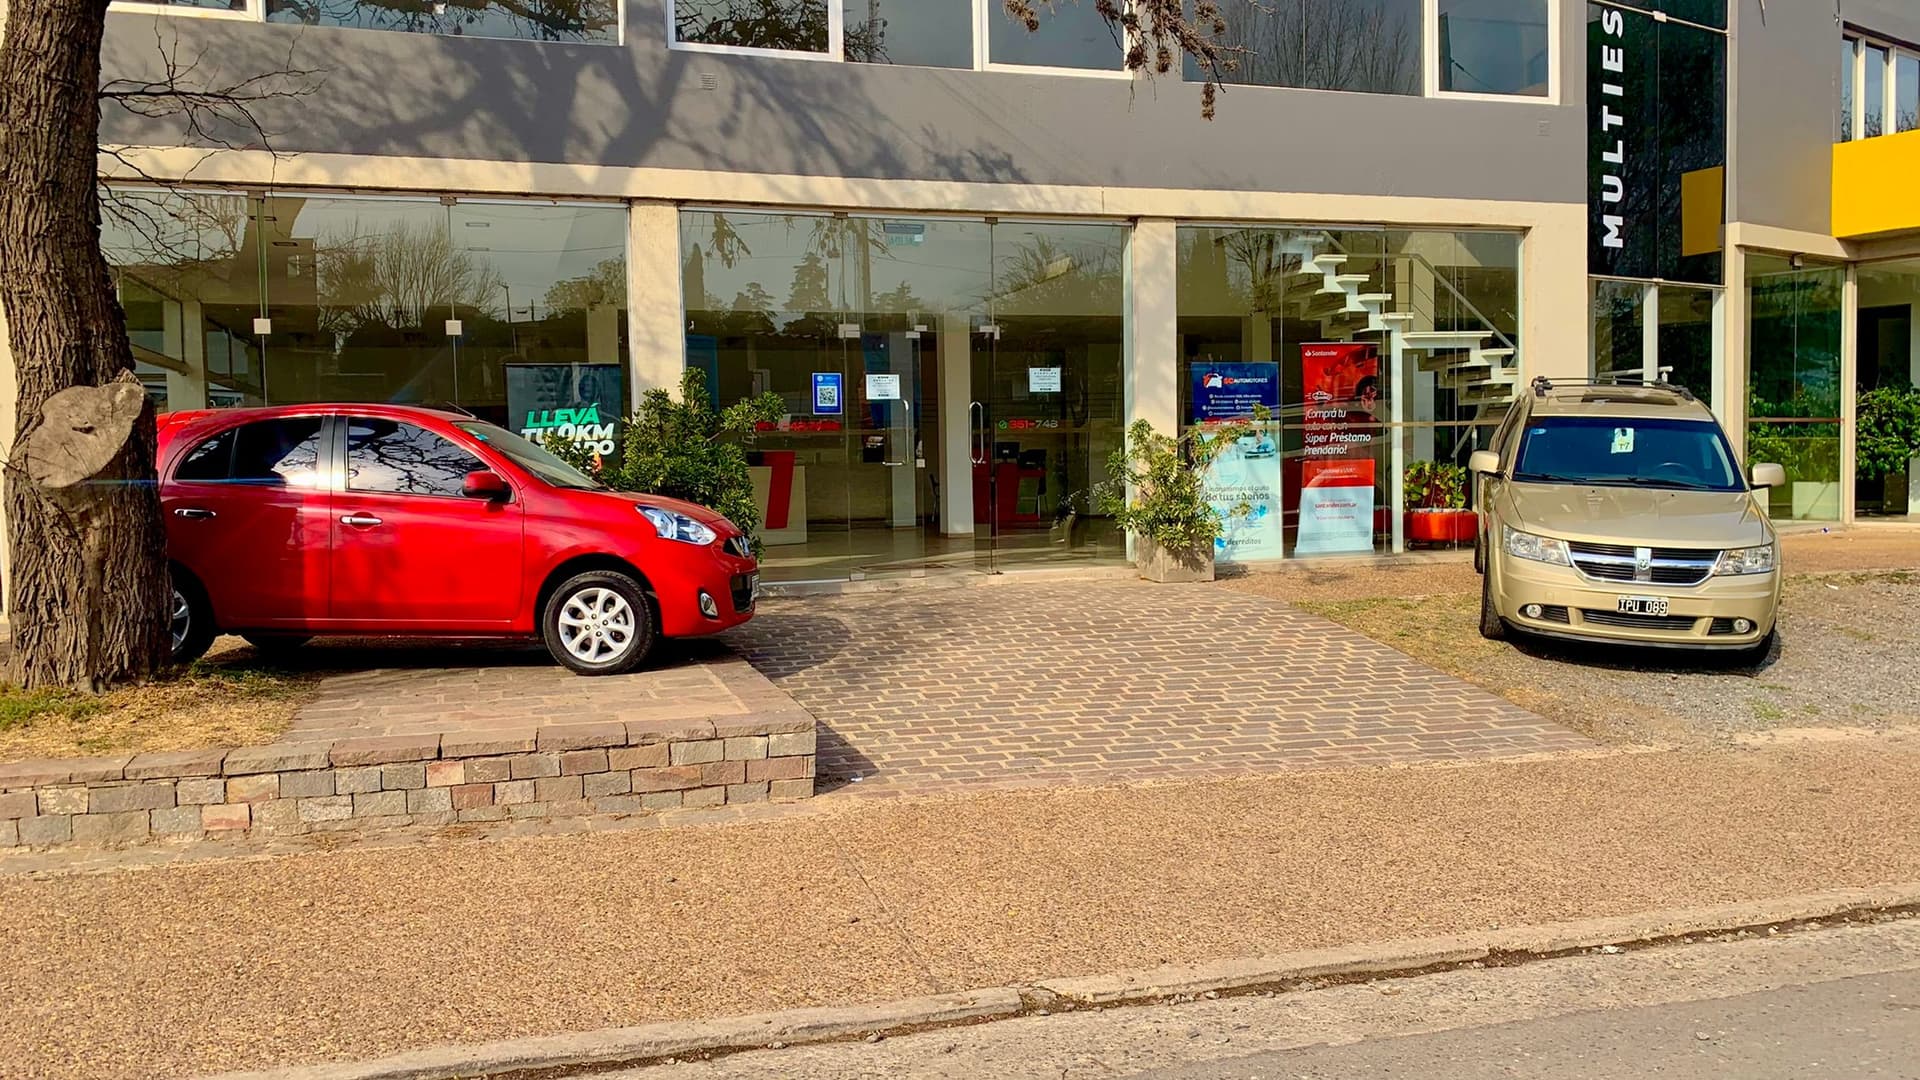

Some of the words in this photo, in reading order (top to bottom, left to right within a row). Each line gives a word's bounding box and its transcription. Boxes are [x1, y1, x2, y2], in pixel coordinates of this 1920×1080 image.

[1602, 8, 1623, 248] MULTIES
[526, 403, 600, 428] LLEVÁ
[1338, 409, 1347, 418] tu
[1304, 432, 1328, 444] Súper
[1329, 431, 1372, 443] Préstamo
[1304, 444, 1348, 455] Prendario!
[1620, 599, 1639, 612] IPU
[1646, 601, 1666, 613] 089
